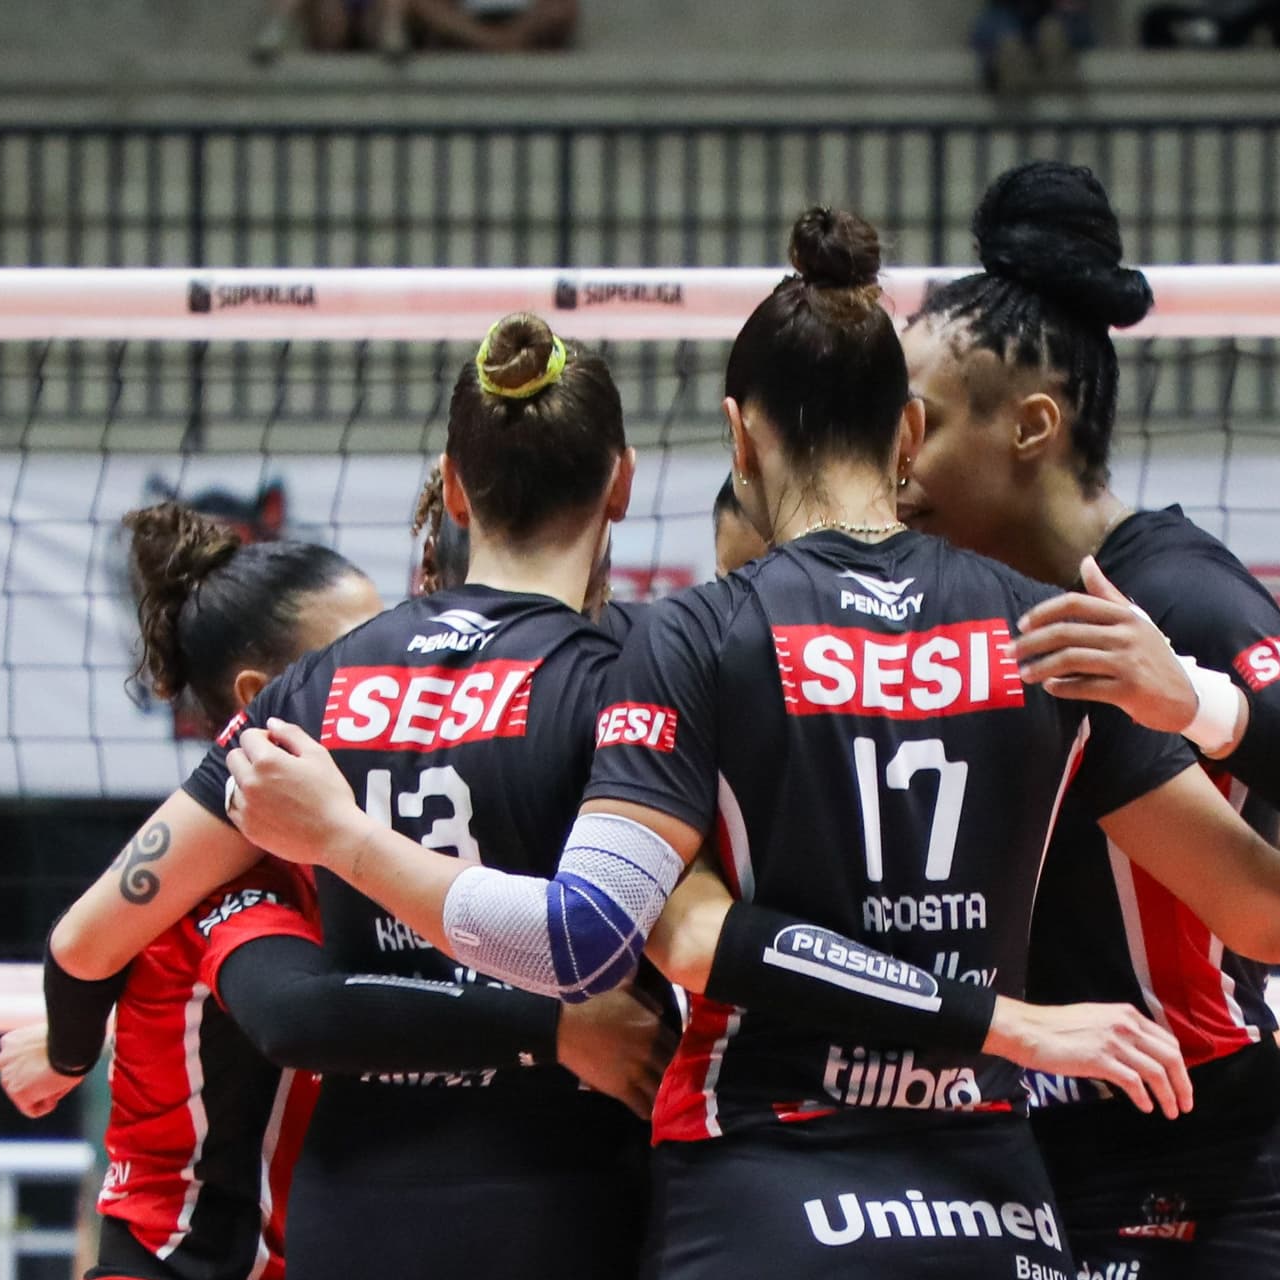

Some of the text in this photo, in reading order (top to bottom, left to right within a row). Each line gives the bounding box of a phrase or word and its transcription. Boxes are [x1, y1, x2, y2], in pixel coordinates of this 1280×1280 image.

[217, 283, 315, 307] SUPERLIGA
[582, 282, 683, 305] SUPERLIGA
[840, 591, 924, 621] PENALTY
[407, 631, 496, 654] PENALTY
[801, 632, 991, 711] SESI
[335, 669, 528, 745] SESI
[853, 736, 969, 882] 17
[862, 892, 987, 932] ACOSTA
[824, 1045, 982, 1111] tilibra
[804, 1191, 1063, 1252] Unimed
